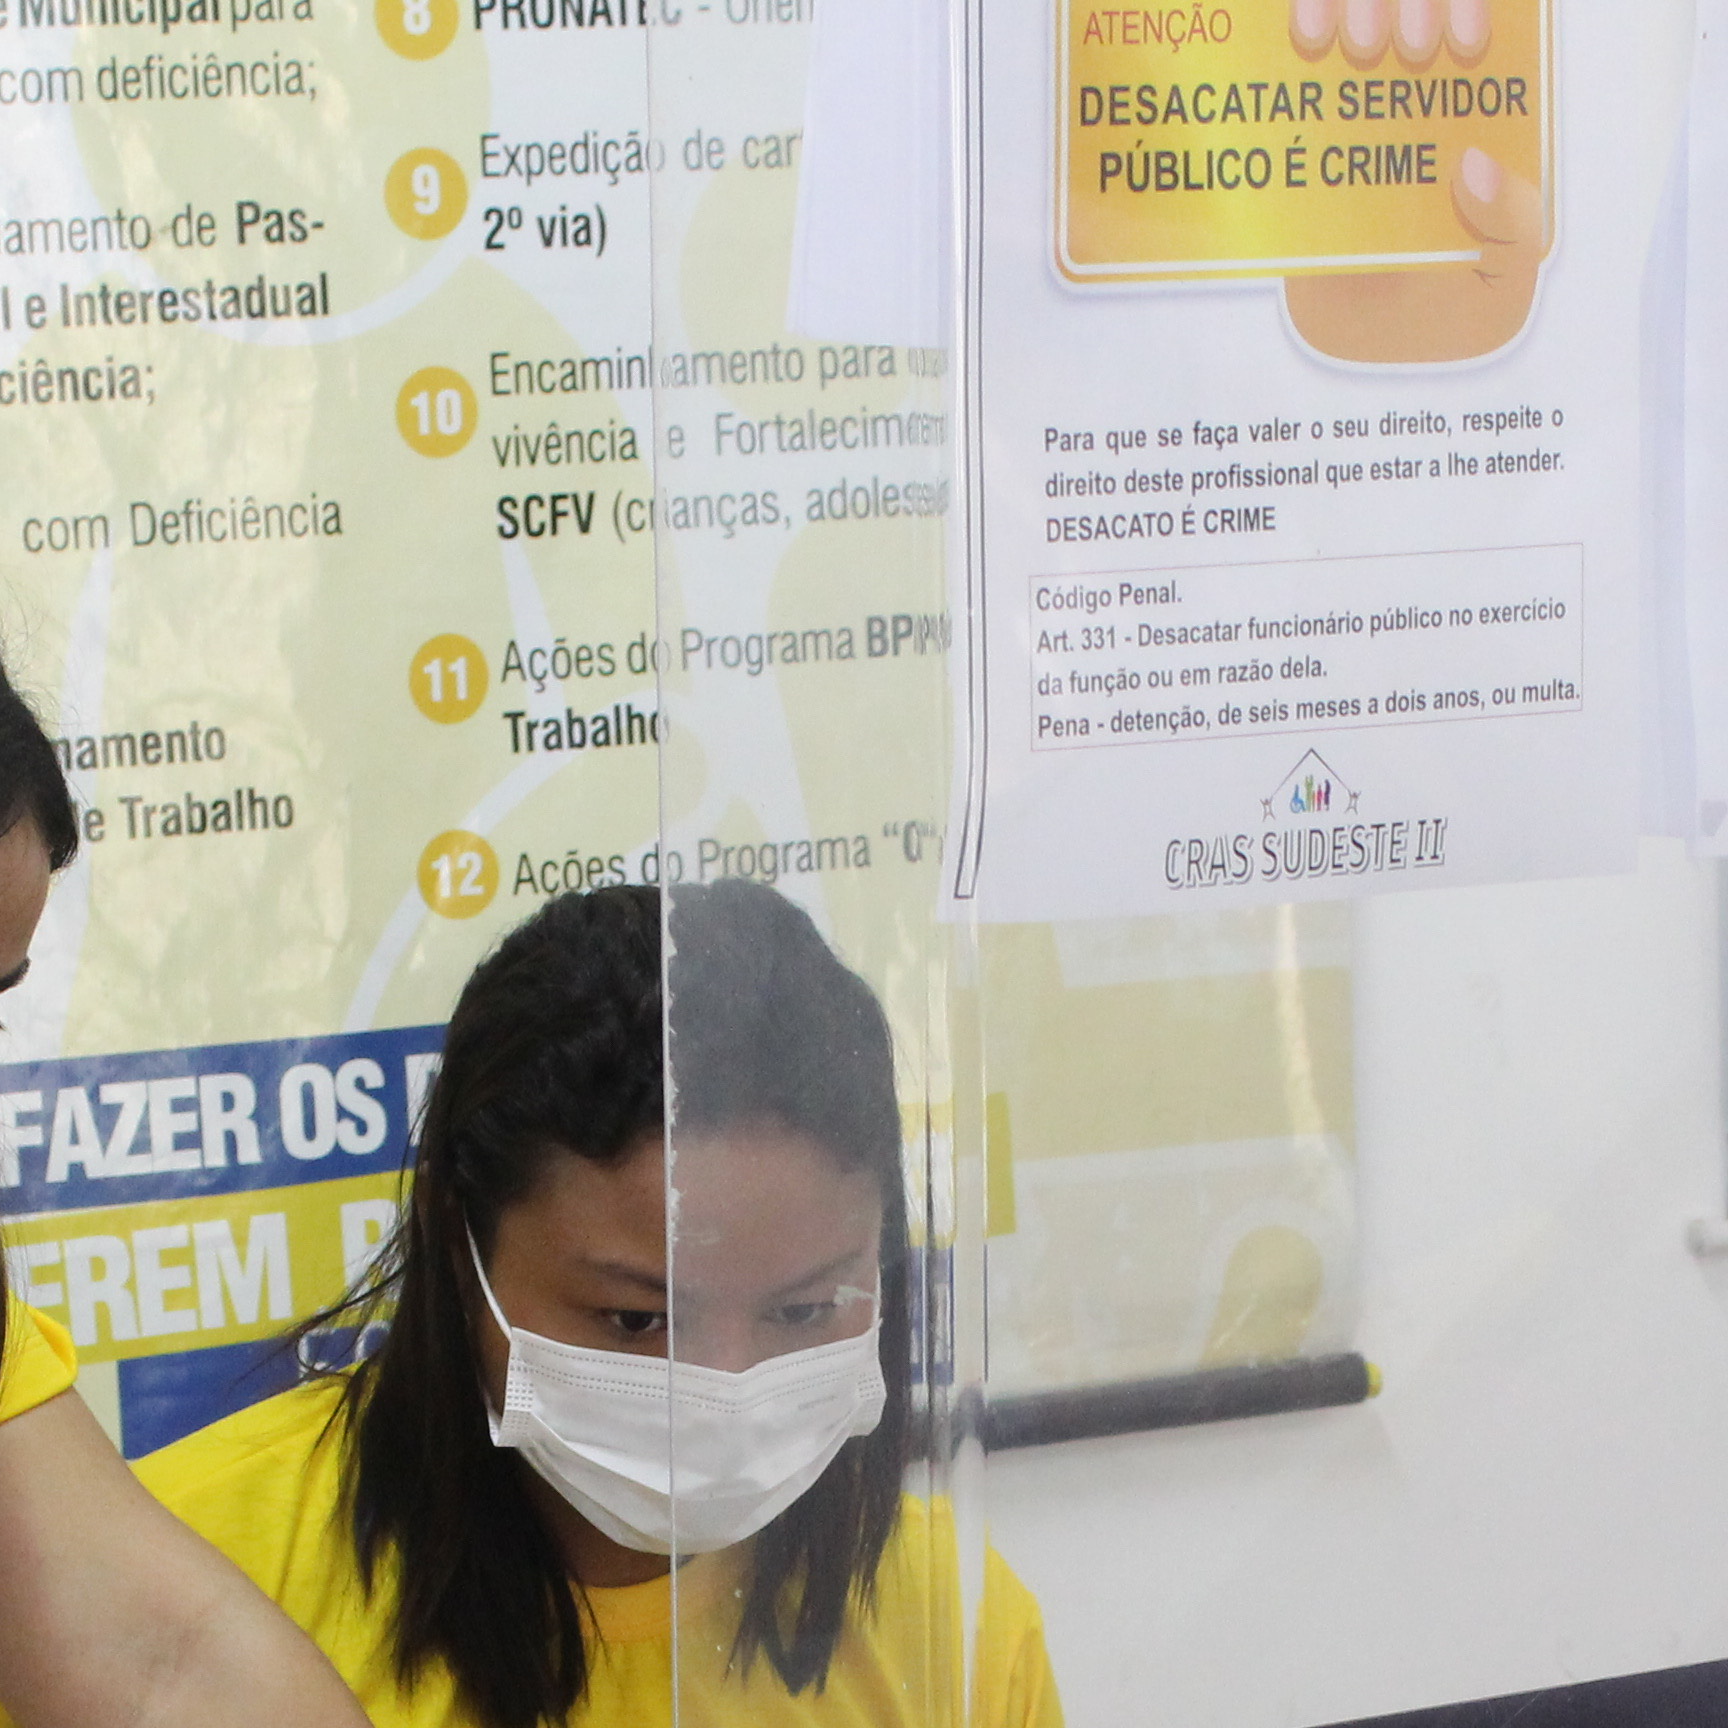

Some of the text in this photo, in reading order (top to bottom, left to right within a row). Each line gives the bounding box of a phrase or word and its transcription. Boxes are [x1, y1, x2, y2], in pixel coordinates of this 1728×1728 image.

[1083, 6, 1233, 52] ATENÇÃO
[96, 50, 318, 103] deficiência;
[1079, 76, 1529, 127] DESACATAR SERVIDOR
[683, 129, 725, 170] de
[743, 129, 803, 169] car
[1099, 133, 1438, 194] PÚBLICO É CRIME
[412, 165, 440, 214] 9
[170, 202, 217, 249] de
[235, 199, 325, 247] Pas-
[483, 203, 607, 257] 2º via)
[24, 294, 47, 330] e
[60, 271, 330, 328] Interestadual
[819, 345, 896, 390] para
[410, 389, 463, 434] 10
[492, 422, 639, 468] vivência
[667, 424, 685, 459] e
[22, 513, 110, 553] com
[130, 492, 344, 547] Deficiência
[496, 491, 597, 541] SCFV
[1046, 503, 1276, 543] DESACATO É CRIME
[1035, 579, 1183, 614] Código Penal.
[1036, 629, 1075, 654] Art.
[1080, 624, 1116, 652] 331
[1137, 620, 1243, 648] Desacatar
[1247, 610, 1365, 641] funcionário
[1369, 605, 1444, 639] público
[1448, 607, 1474, 627] no
[1478, 596, 1567, 625] exercício
[422, 657, 469, 702] 11
[501, 639, 615, 692] Ações
[680, 626, 857, 677] Programa
[1037, 654, 1328, 698] da função ou em razão dela.
[503, 704, 669, 755] Trabalho
[118, 786, 294, 840] Trabalho
[432, 854, 484, 900] 12
[642, 843, 683, 884] do
[698, 834, 871, 884] Programa
[1165, 833, 1255, 889] CRAS
[1261, 820, 1410, 882] SUDESTE
[278, 1058, 388, 1161] OS
